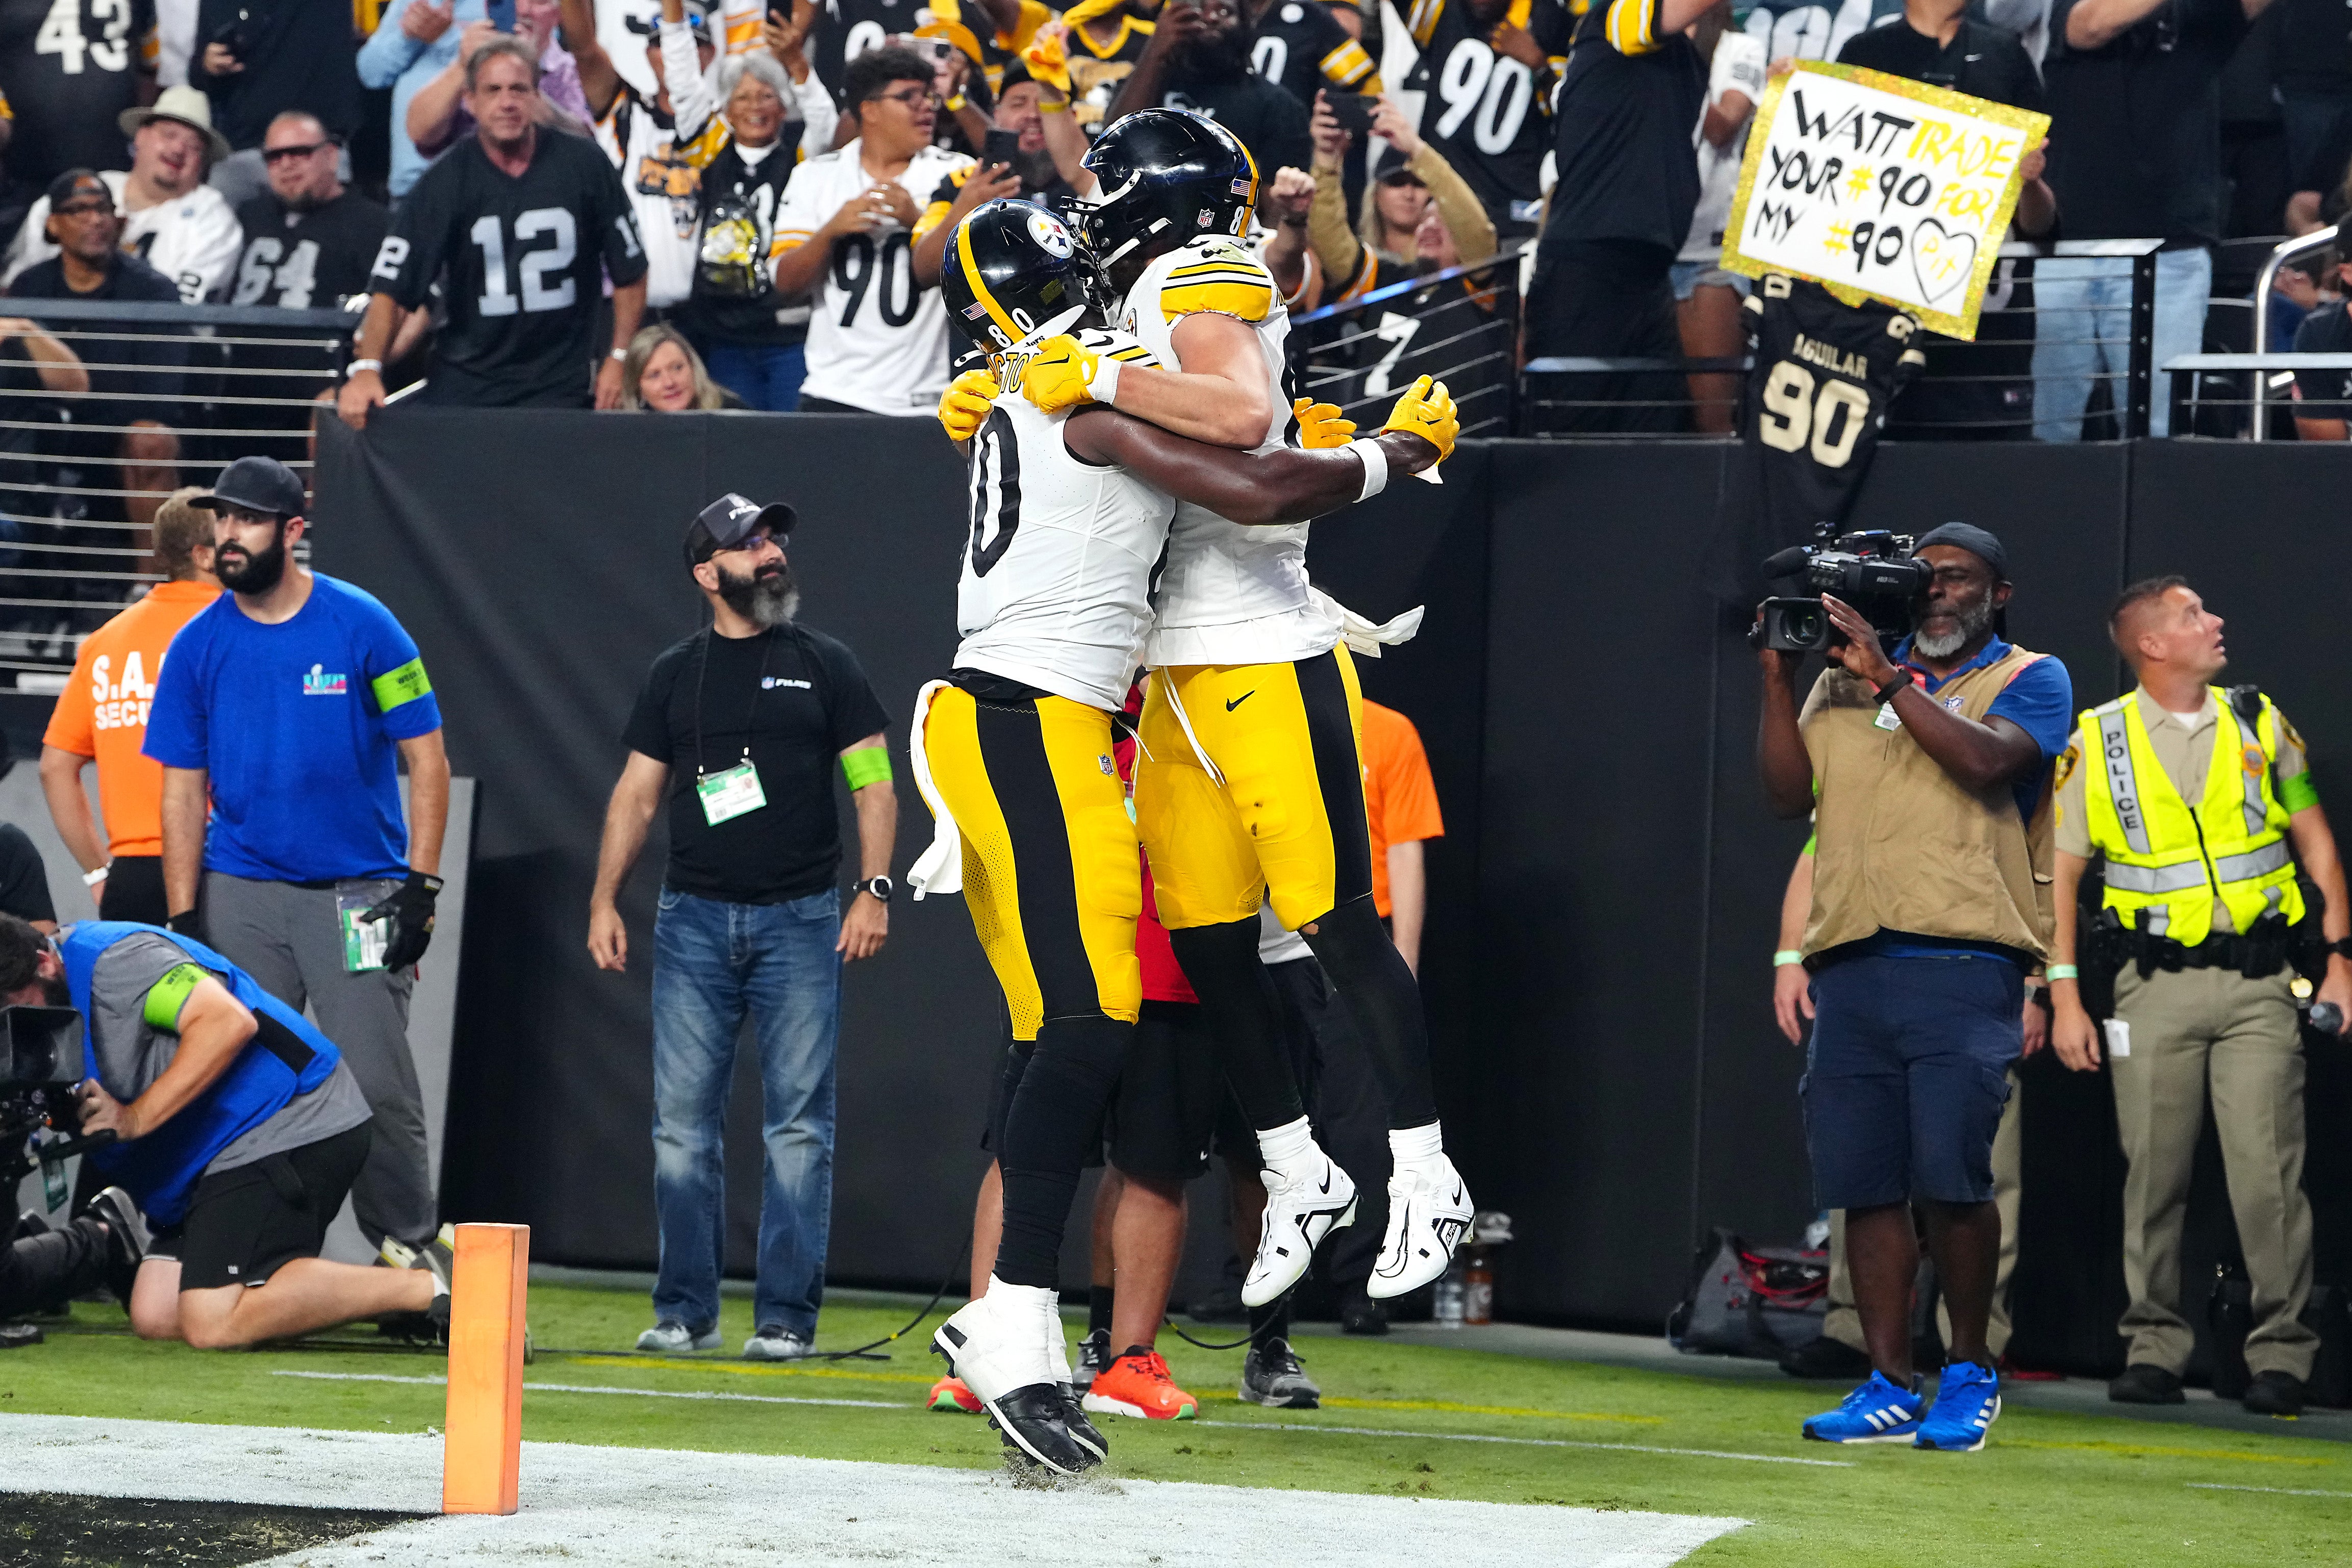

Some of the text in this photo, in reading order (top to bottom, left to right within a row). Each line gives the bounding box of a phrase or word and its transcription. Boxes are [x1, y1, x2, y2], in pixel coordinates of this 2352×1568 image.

[35, 0, 132, 73] 43
[1434, 38, 1531, 154] 90
[1793, 90, 2017, 179] WATT TRADE
[1200, 216, 1210, 225] NFL
[1229, 206, 1245, 235] 8
[1767, 145, 1994, 227] YOUR #90 FOR
[231, 237, 320, 309] 64
[471, 207, 577, 317] 12
[1753, 199, 1903, 273] MY #90
[833, 233, 920, 327] 90
[1364, 311, 1421, 397] 7
[1792, 333, 1867, 380] AGUILAR
[1760, 360, 1870, 468] 90
[92, 651, 167, 703] S.A.
[2107, 731, 2139, 829] POLICE
